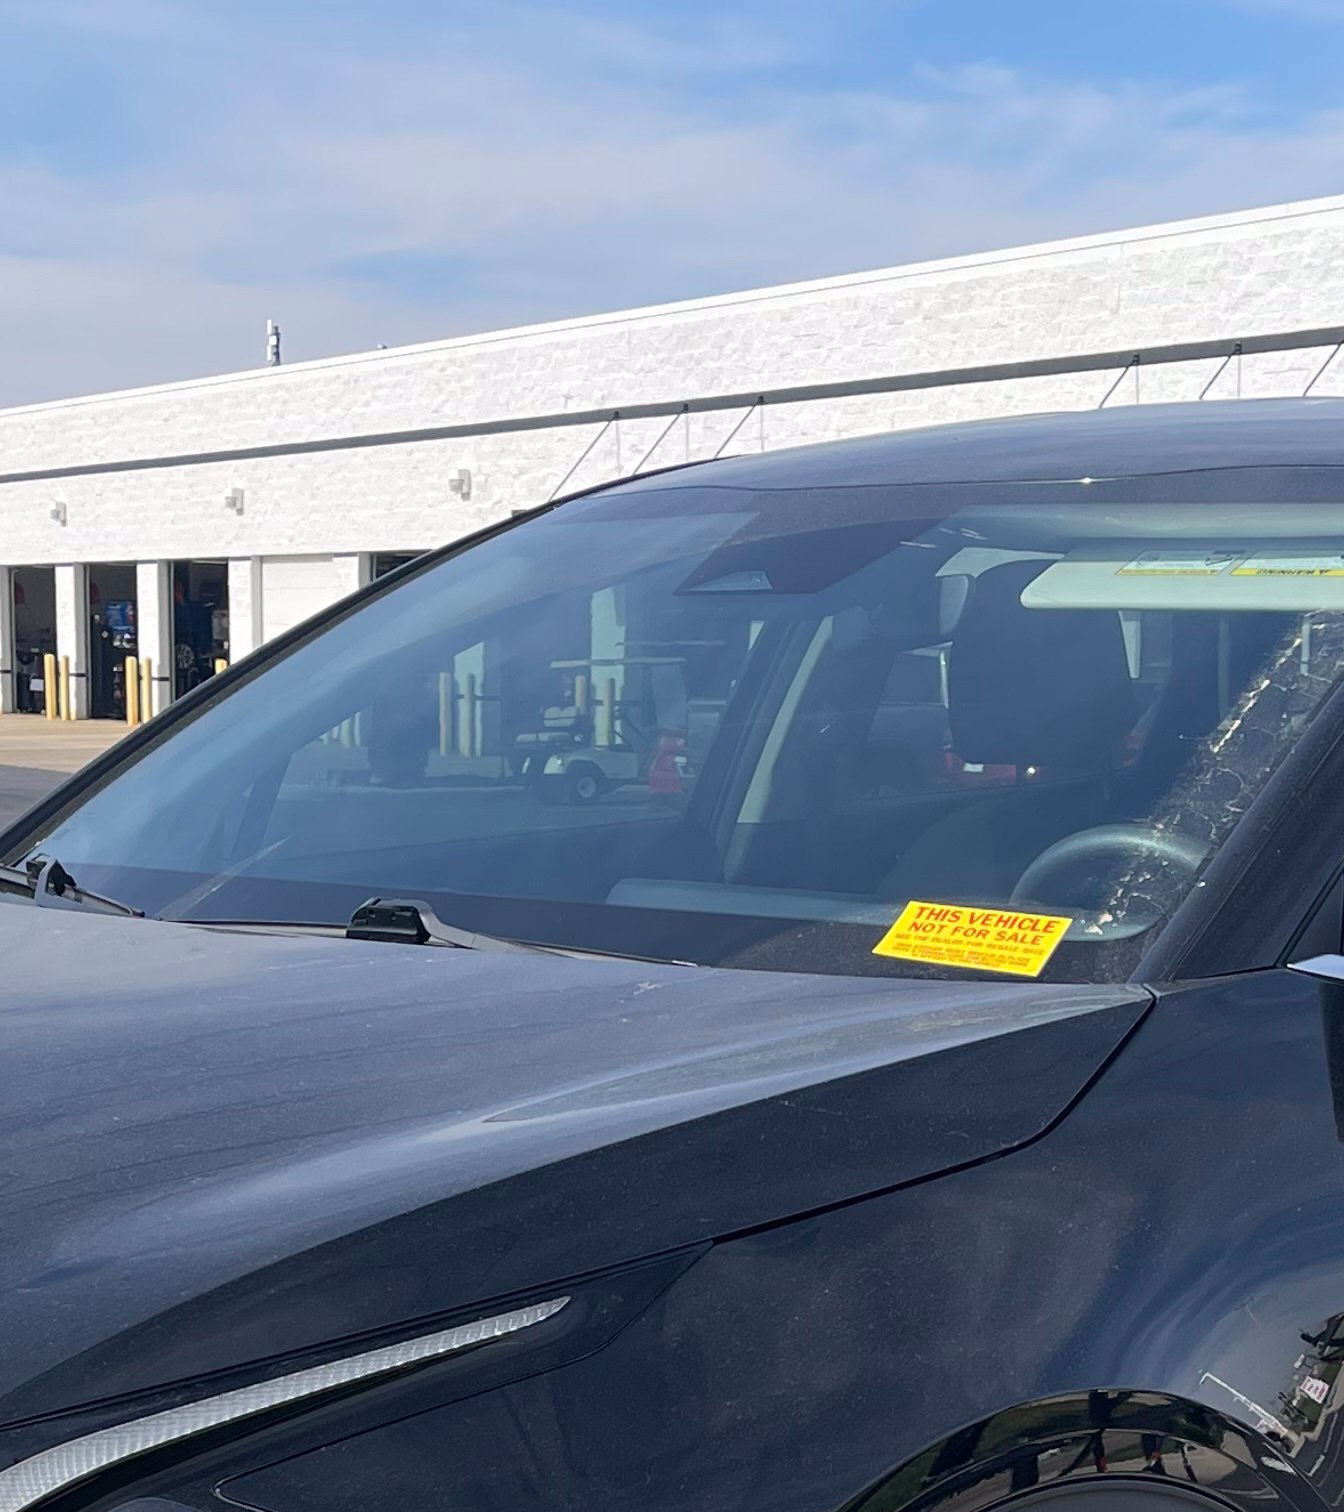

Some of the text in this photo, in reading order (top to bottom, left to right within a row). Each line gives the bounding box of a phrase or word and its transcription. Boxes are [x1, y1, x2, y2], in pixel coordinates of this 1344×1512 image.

[915, 906, 1061, 934] THIS VEHICLE
[908, 921, 1046, 946] NOT FOR SALE
